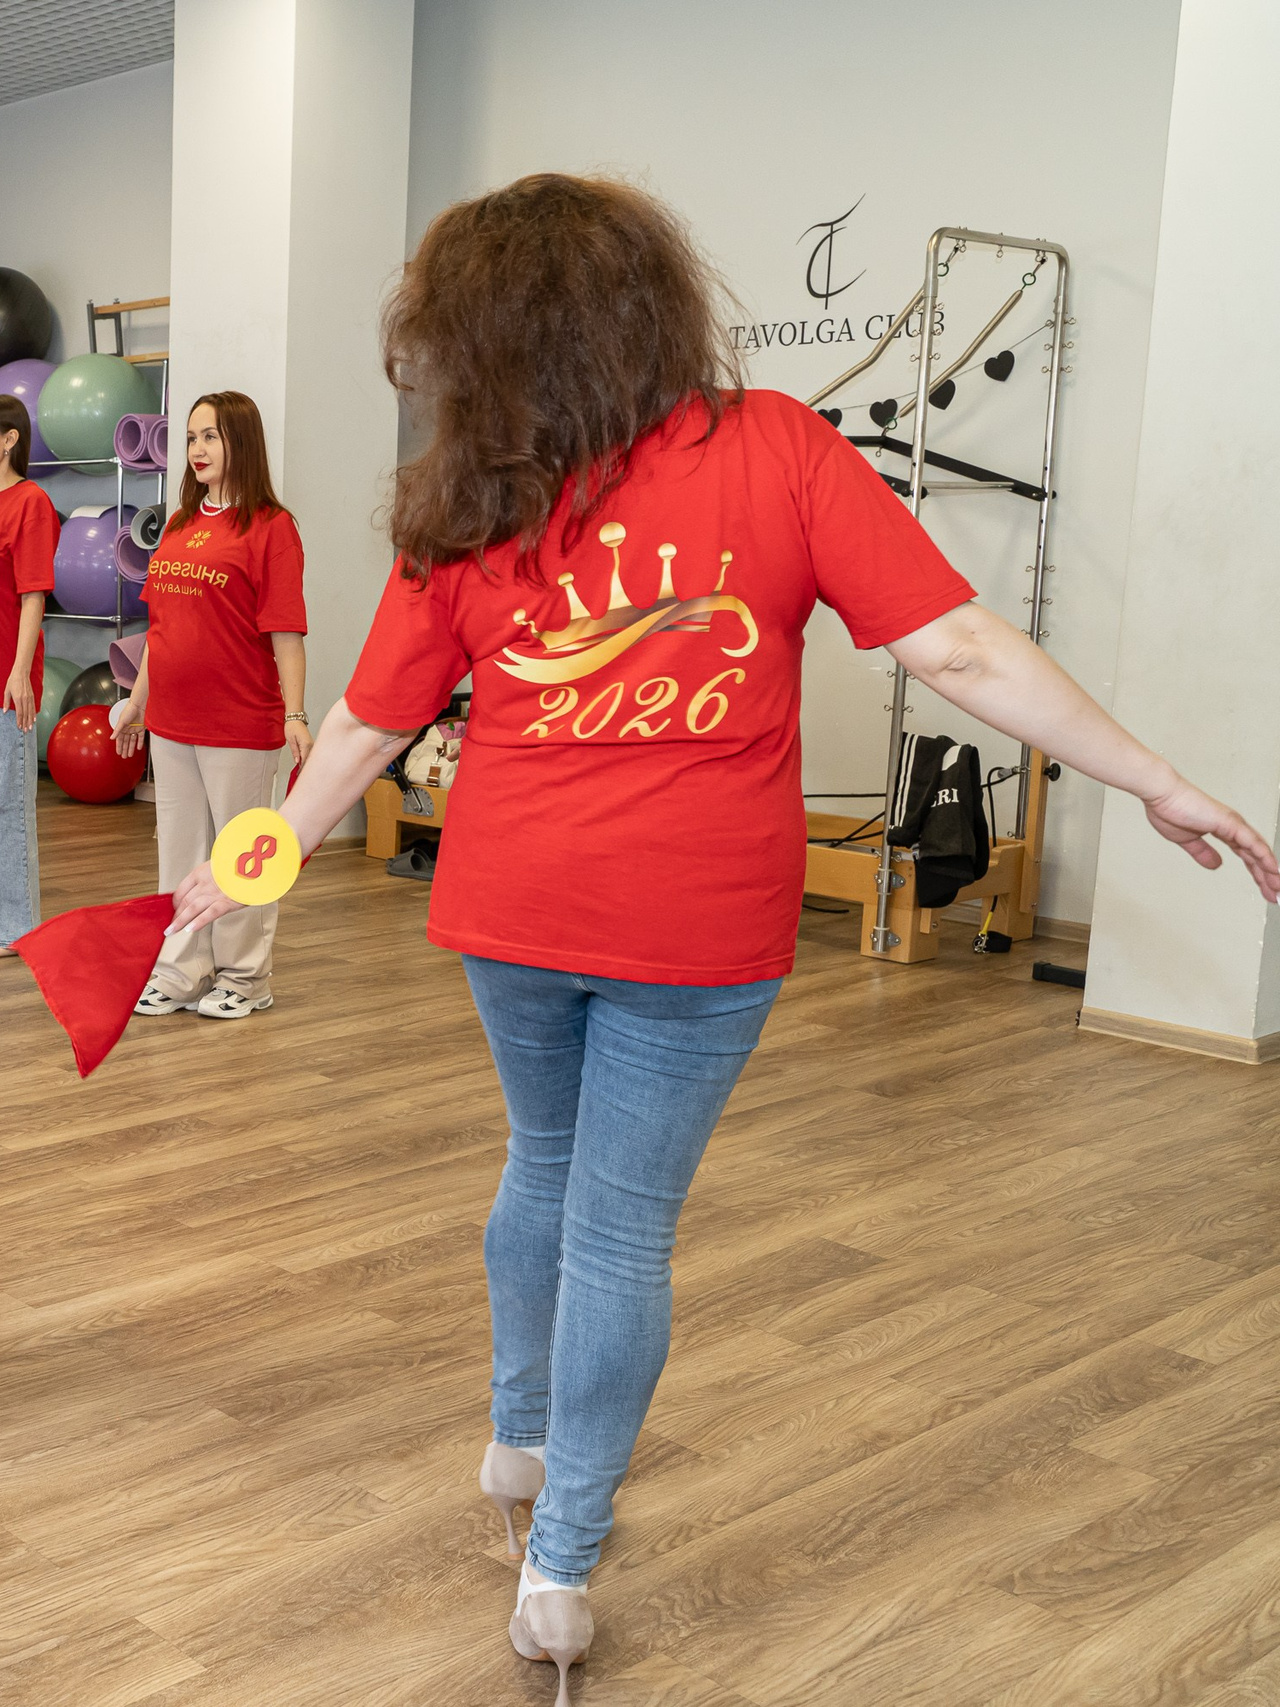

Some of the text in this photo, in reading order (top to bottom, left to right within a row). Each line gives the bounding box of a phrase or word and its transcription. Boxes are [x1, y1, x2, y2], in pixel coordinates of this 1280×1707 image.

[729, 317, 856, 351] TAVOLGA
[149, 559, 229, 589] ерегиня
[521, 667, 747, 740] 2026
[931, 787, 959, 808] RI
